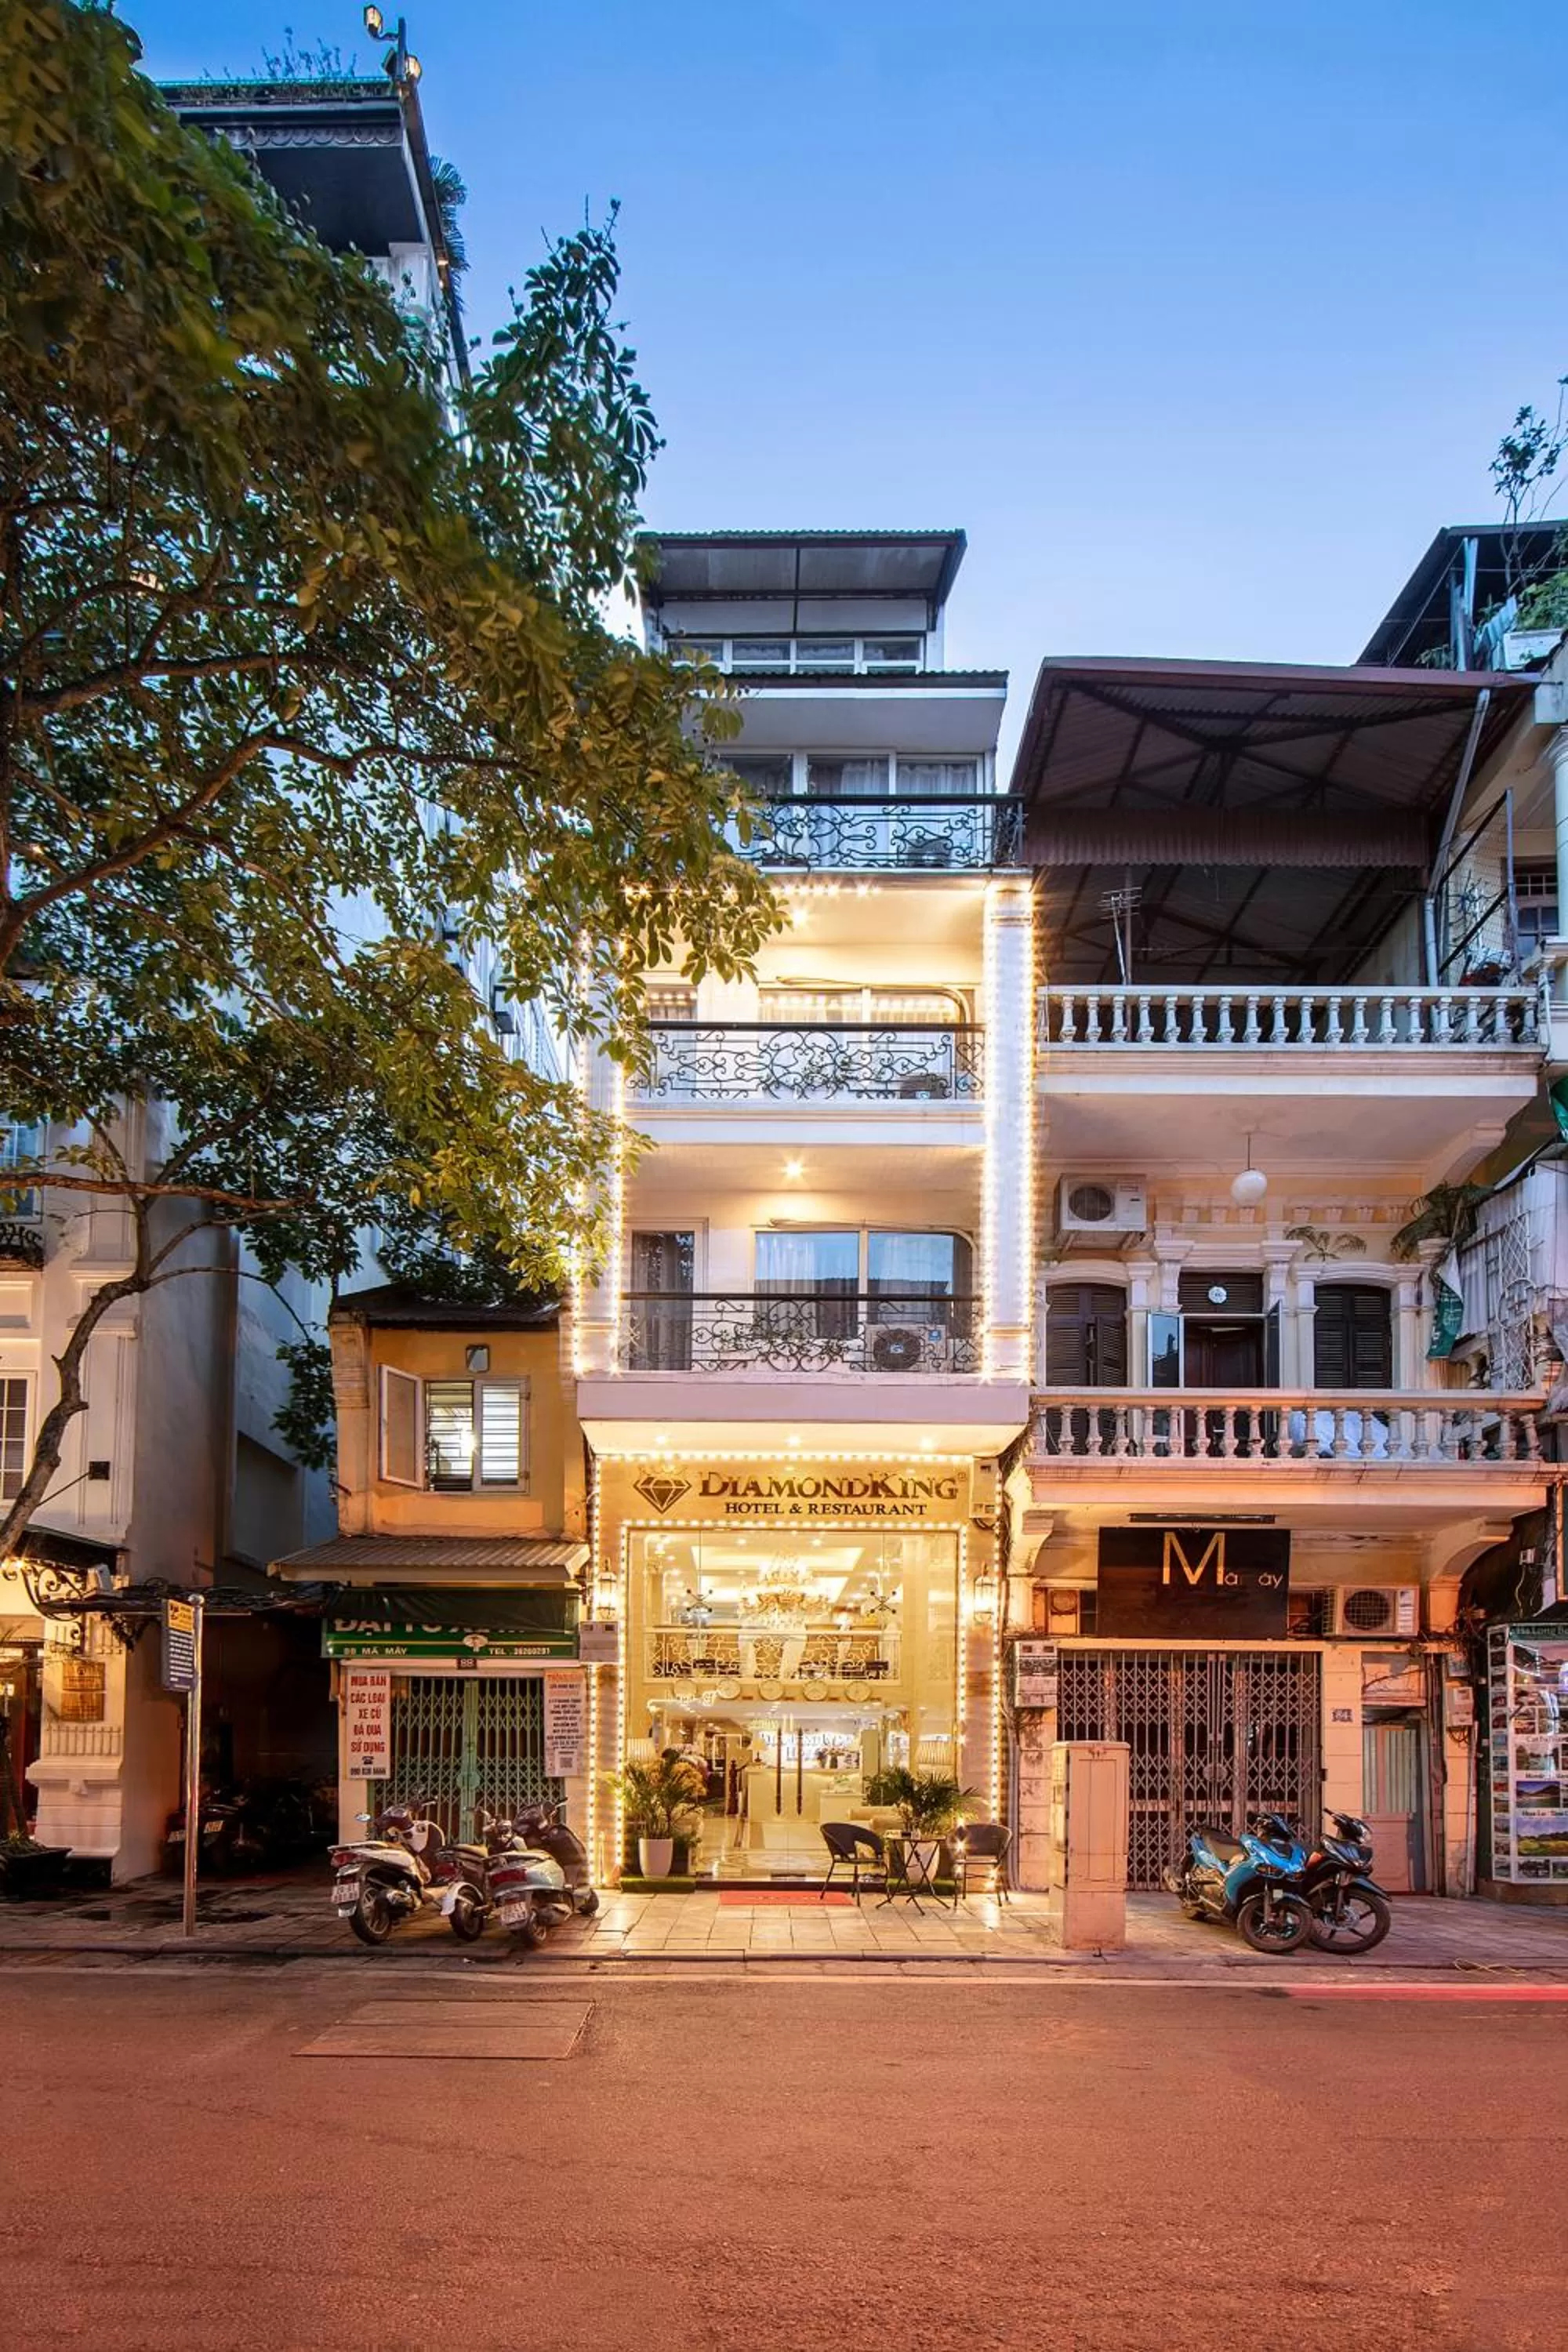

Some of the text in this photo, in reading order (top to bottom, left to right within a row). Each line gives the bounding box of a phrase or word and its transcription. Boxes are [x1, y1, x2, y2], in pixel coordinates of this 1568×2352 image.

[724, 1501, 927, 1515] HOTEL & RESTAURANT
